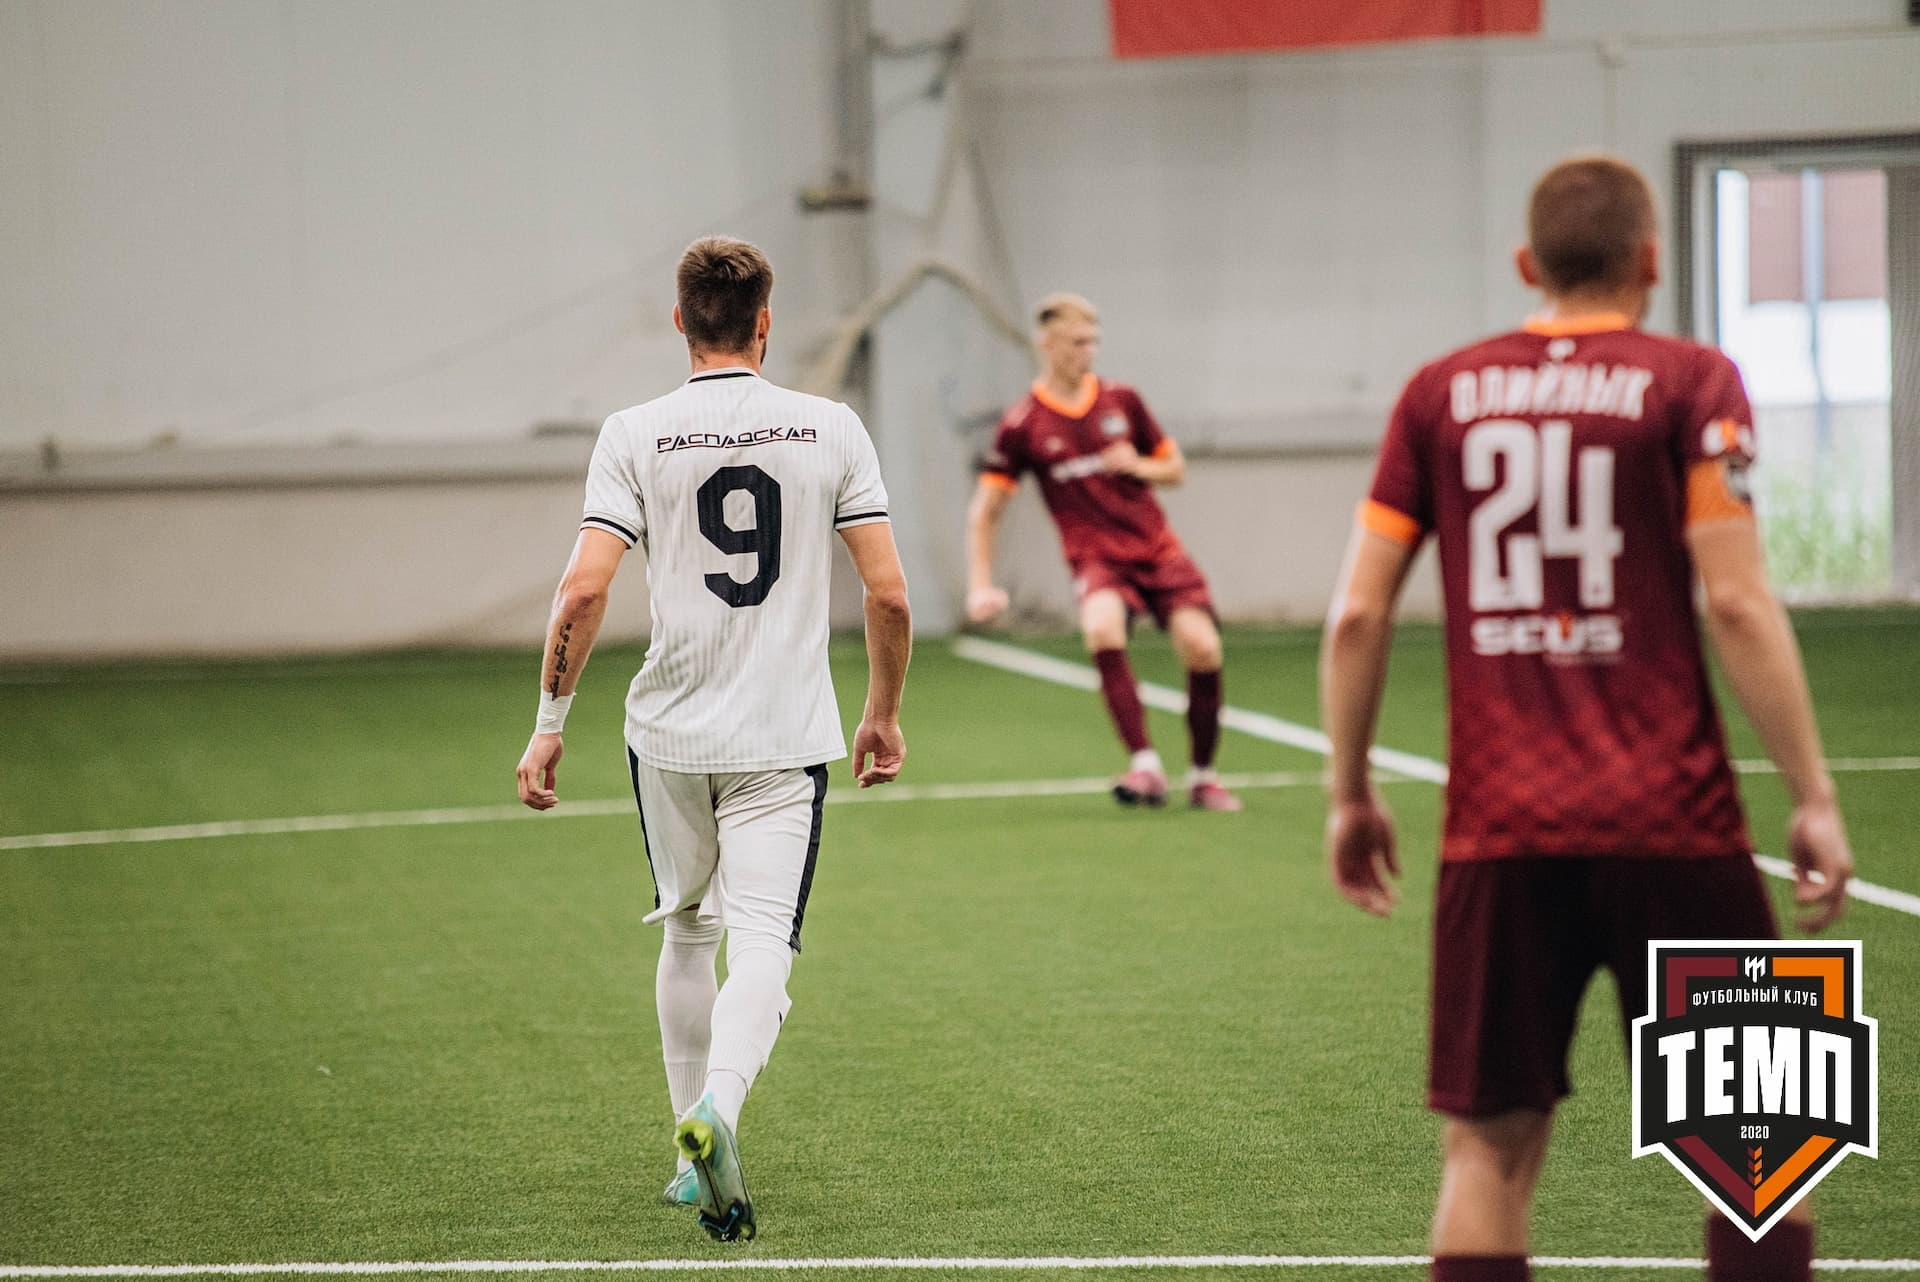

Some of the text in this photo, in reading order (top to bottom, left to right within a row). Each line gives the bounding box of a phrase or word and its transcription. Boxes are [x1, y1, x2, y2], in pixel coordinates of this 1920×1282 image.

[657, 427, 817, 453] РАСПАДСКАЯ
[697, 464, 781, 608] 9
[1462, 419, 1624, 610] 24
